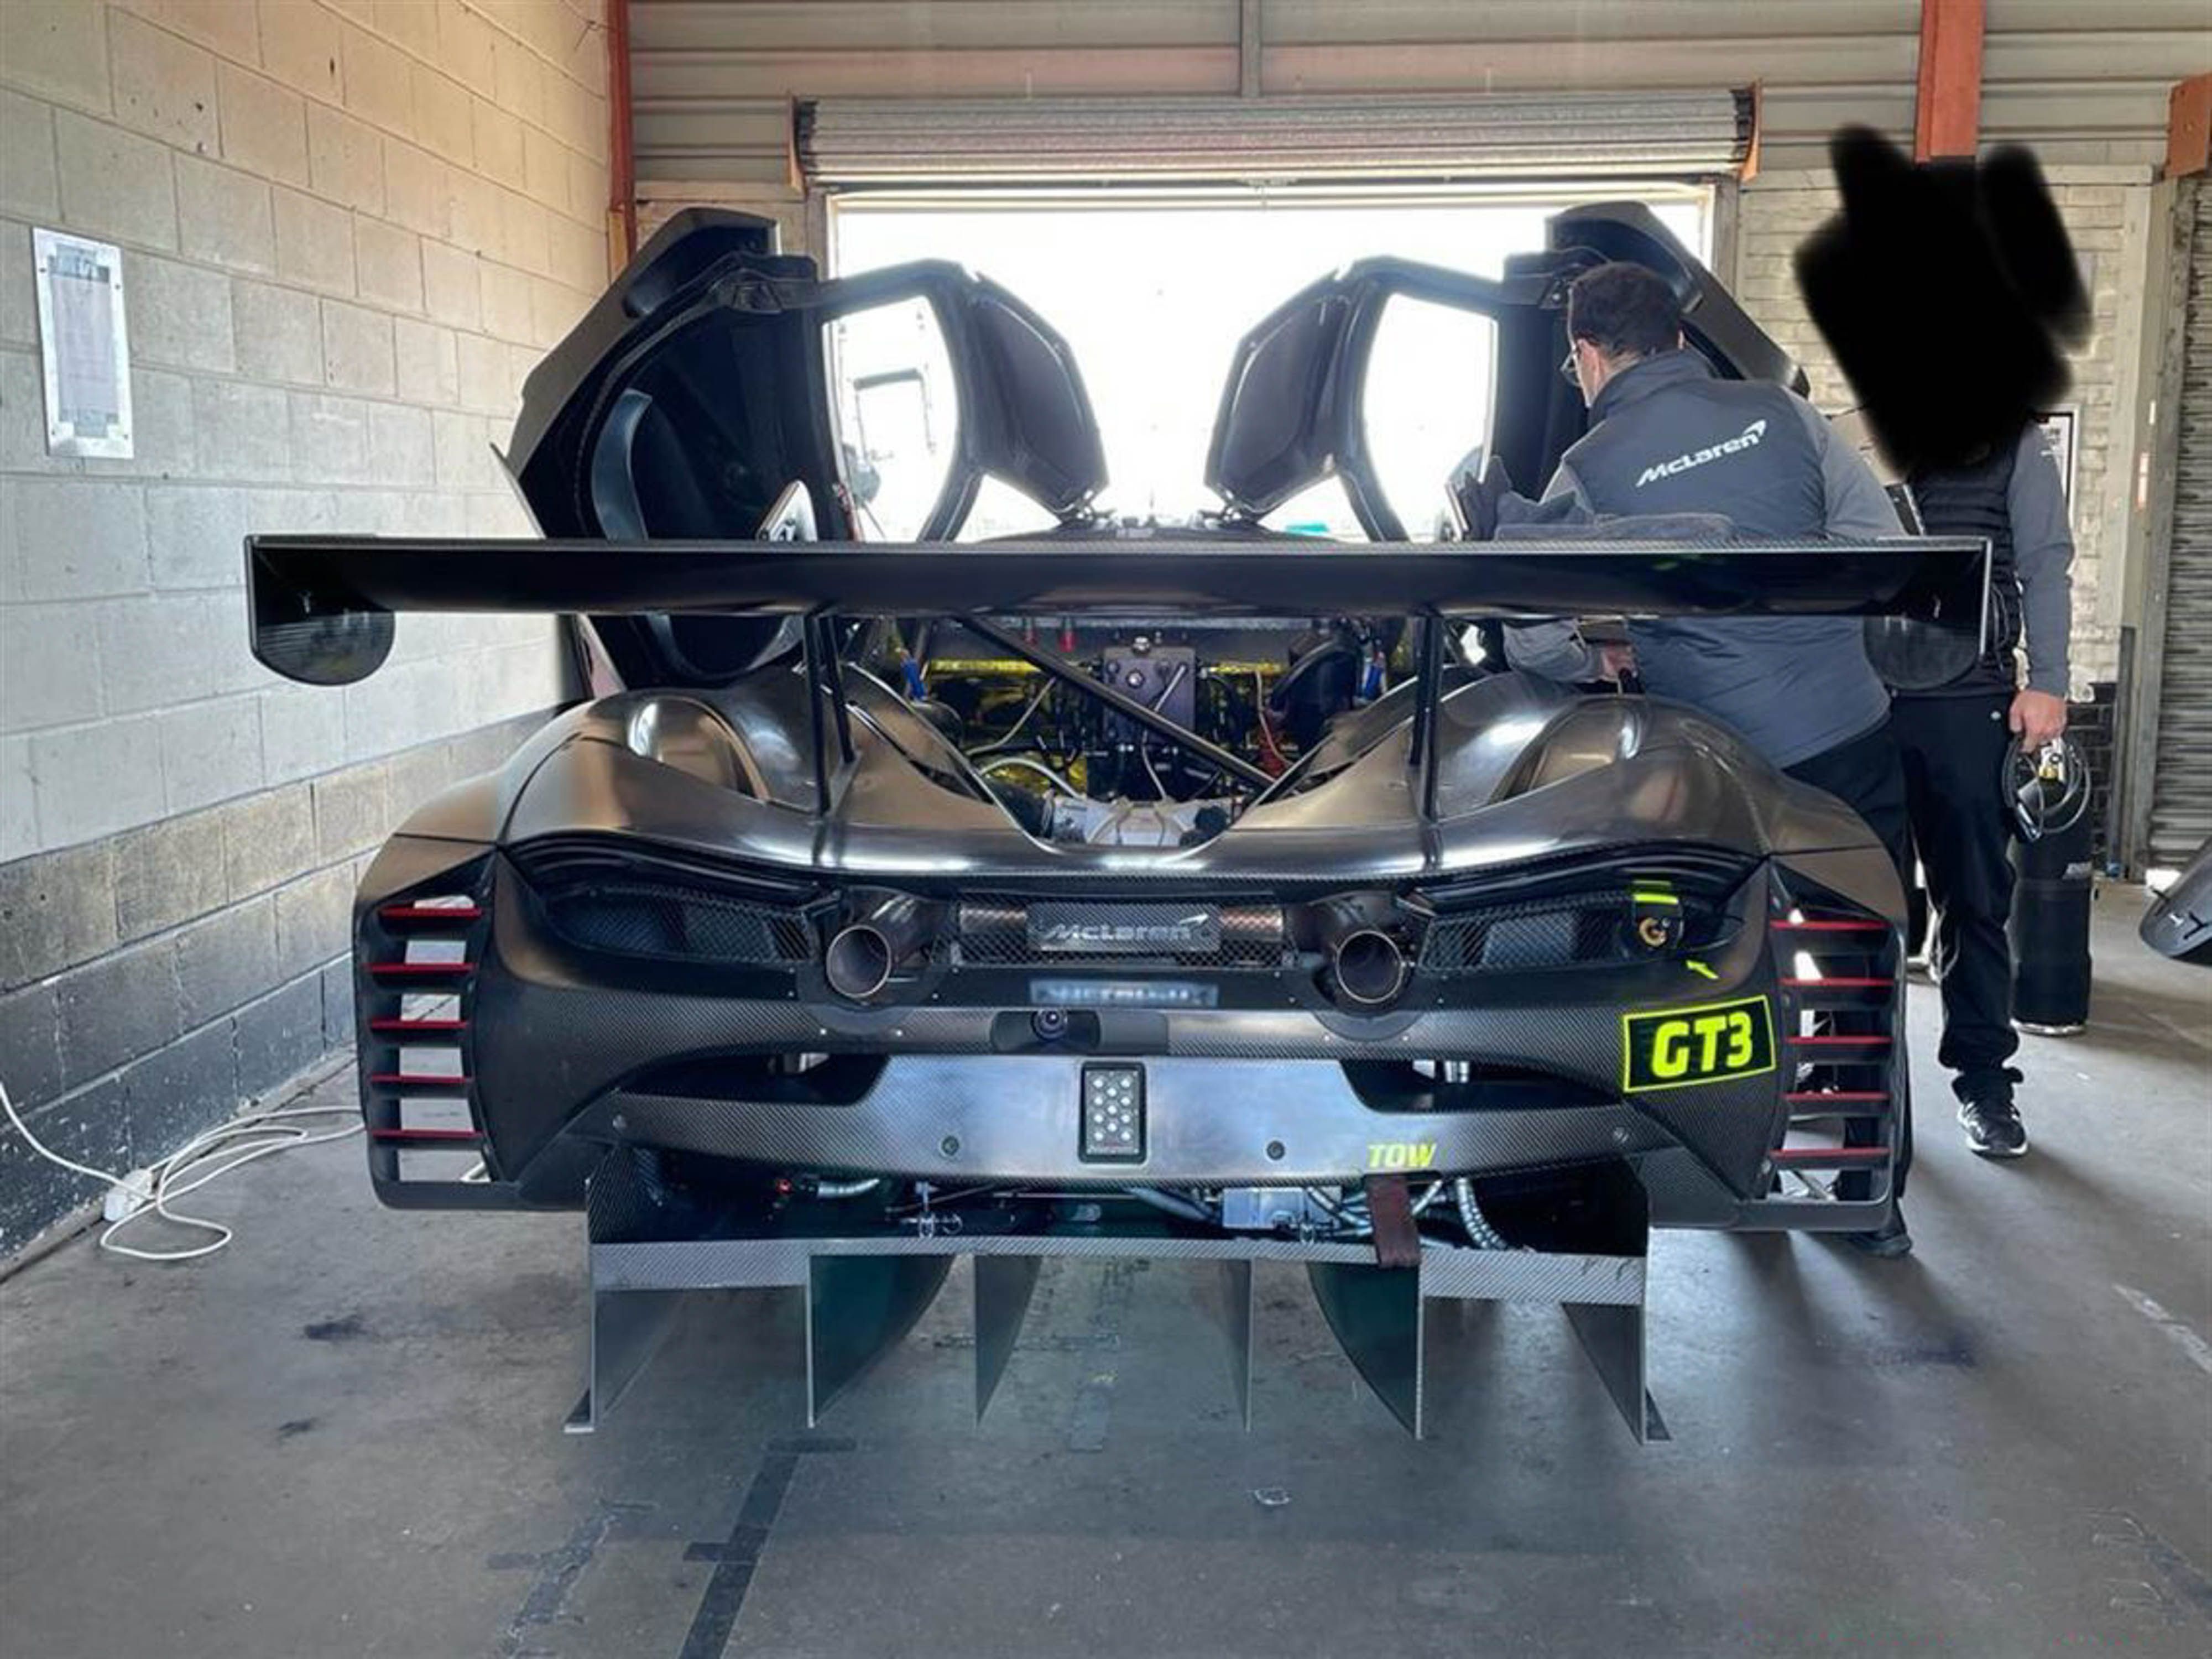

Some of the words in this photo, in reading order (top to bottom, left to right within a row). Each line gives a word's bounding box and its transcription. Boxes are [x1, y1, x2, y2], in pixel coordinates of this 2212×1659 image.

[1635, 434, 1760, 488] McLaren
[1043, 923, 1191, 940] McLaren
[1651, 1011, 1753, 1078] GT3
[1368, 1142, 1437, 1168] TOW
